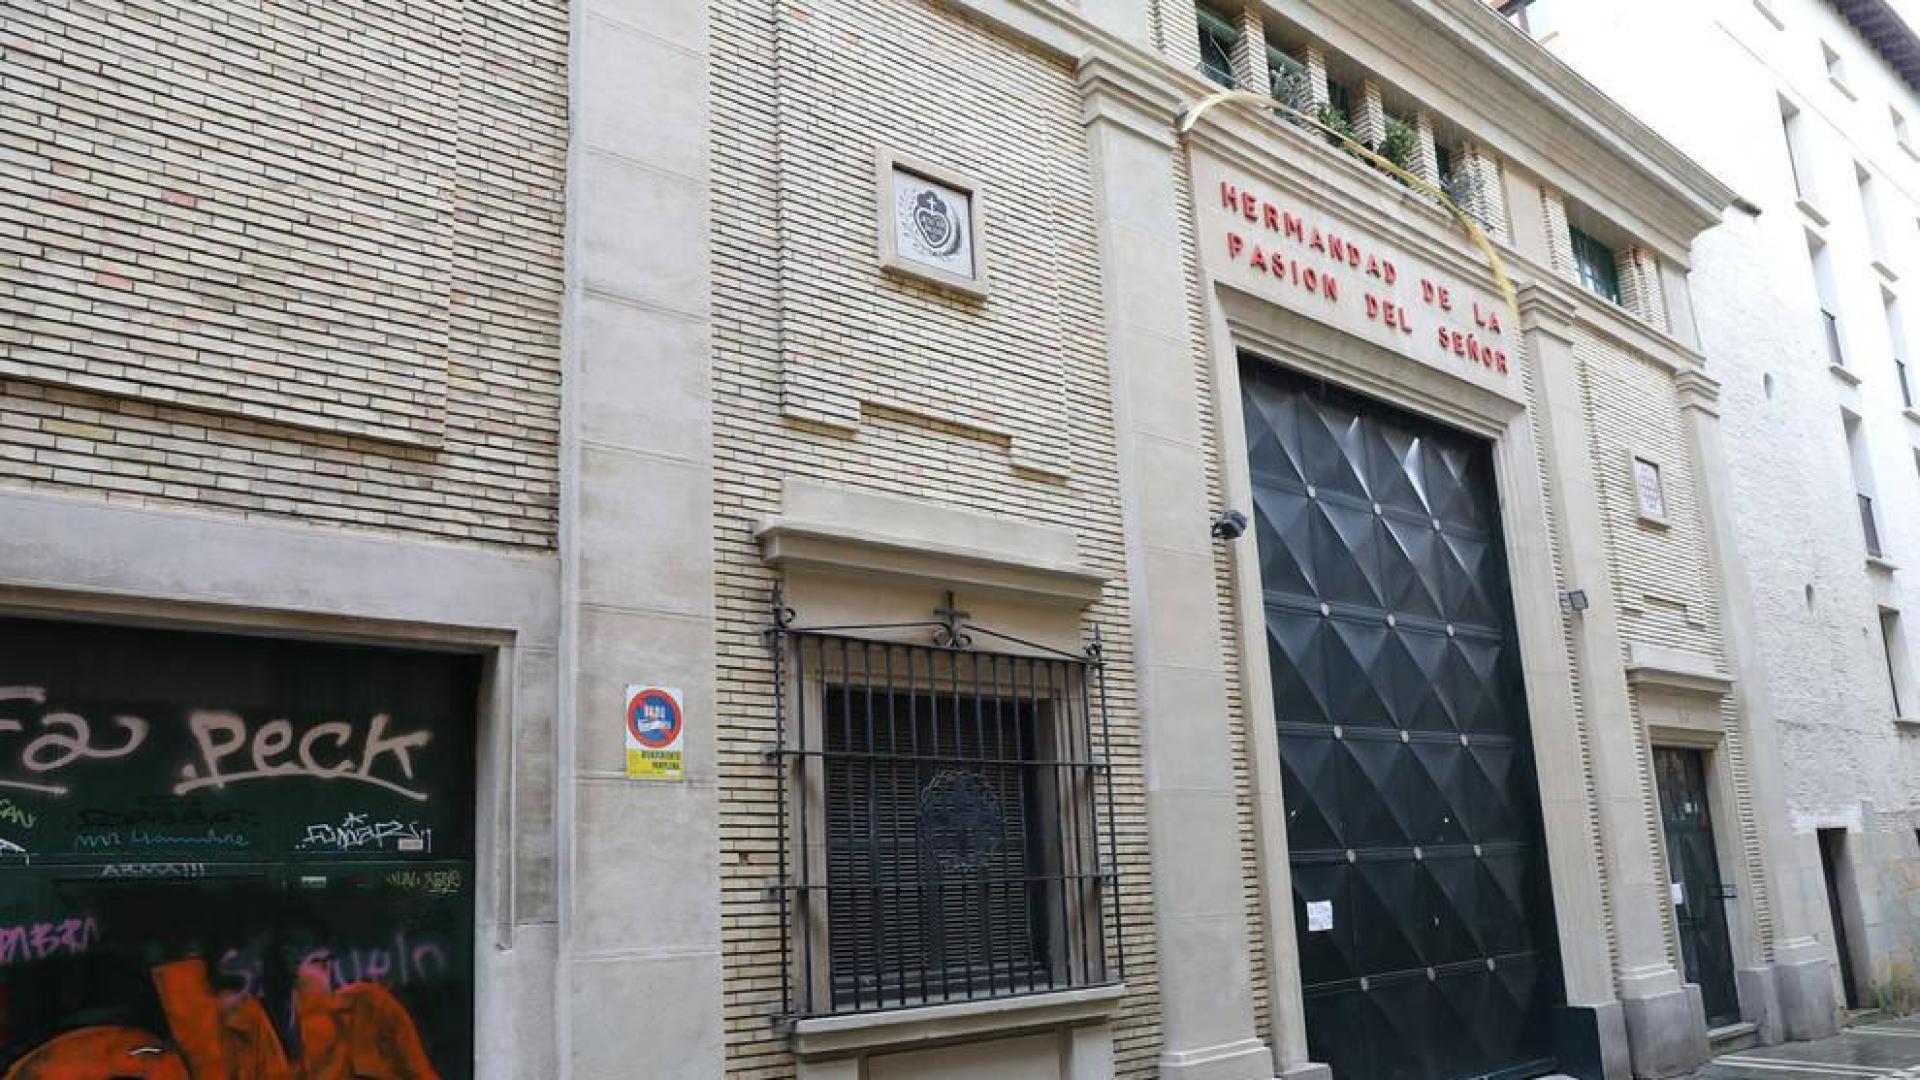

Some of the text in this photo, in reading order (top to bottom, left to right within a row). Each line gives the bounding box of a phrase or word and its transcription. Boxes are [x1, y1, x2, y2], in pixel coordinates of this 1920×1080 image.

[1219, 180, 1503, 335] HERMANDAD DE LA
[1226, 231, 1509, 375] PASION DEL SEÑOR
